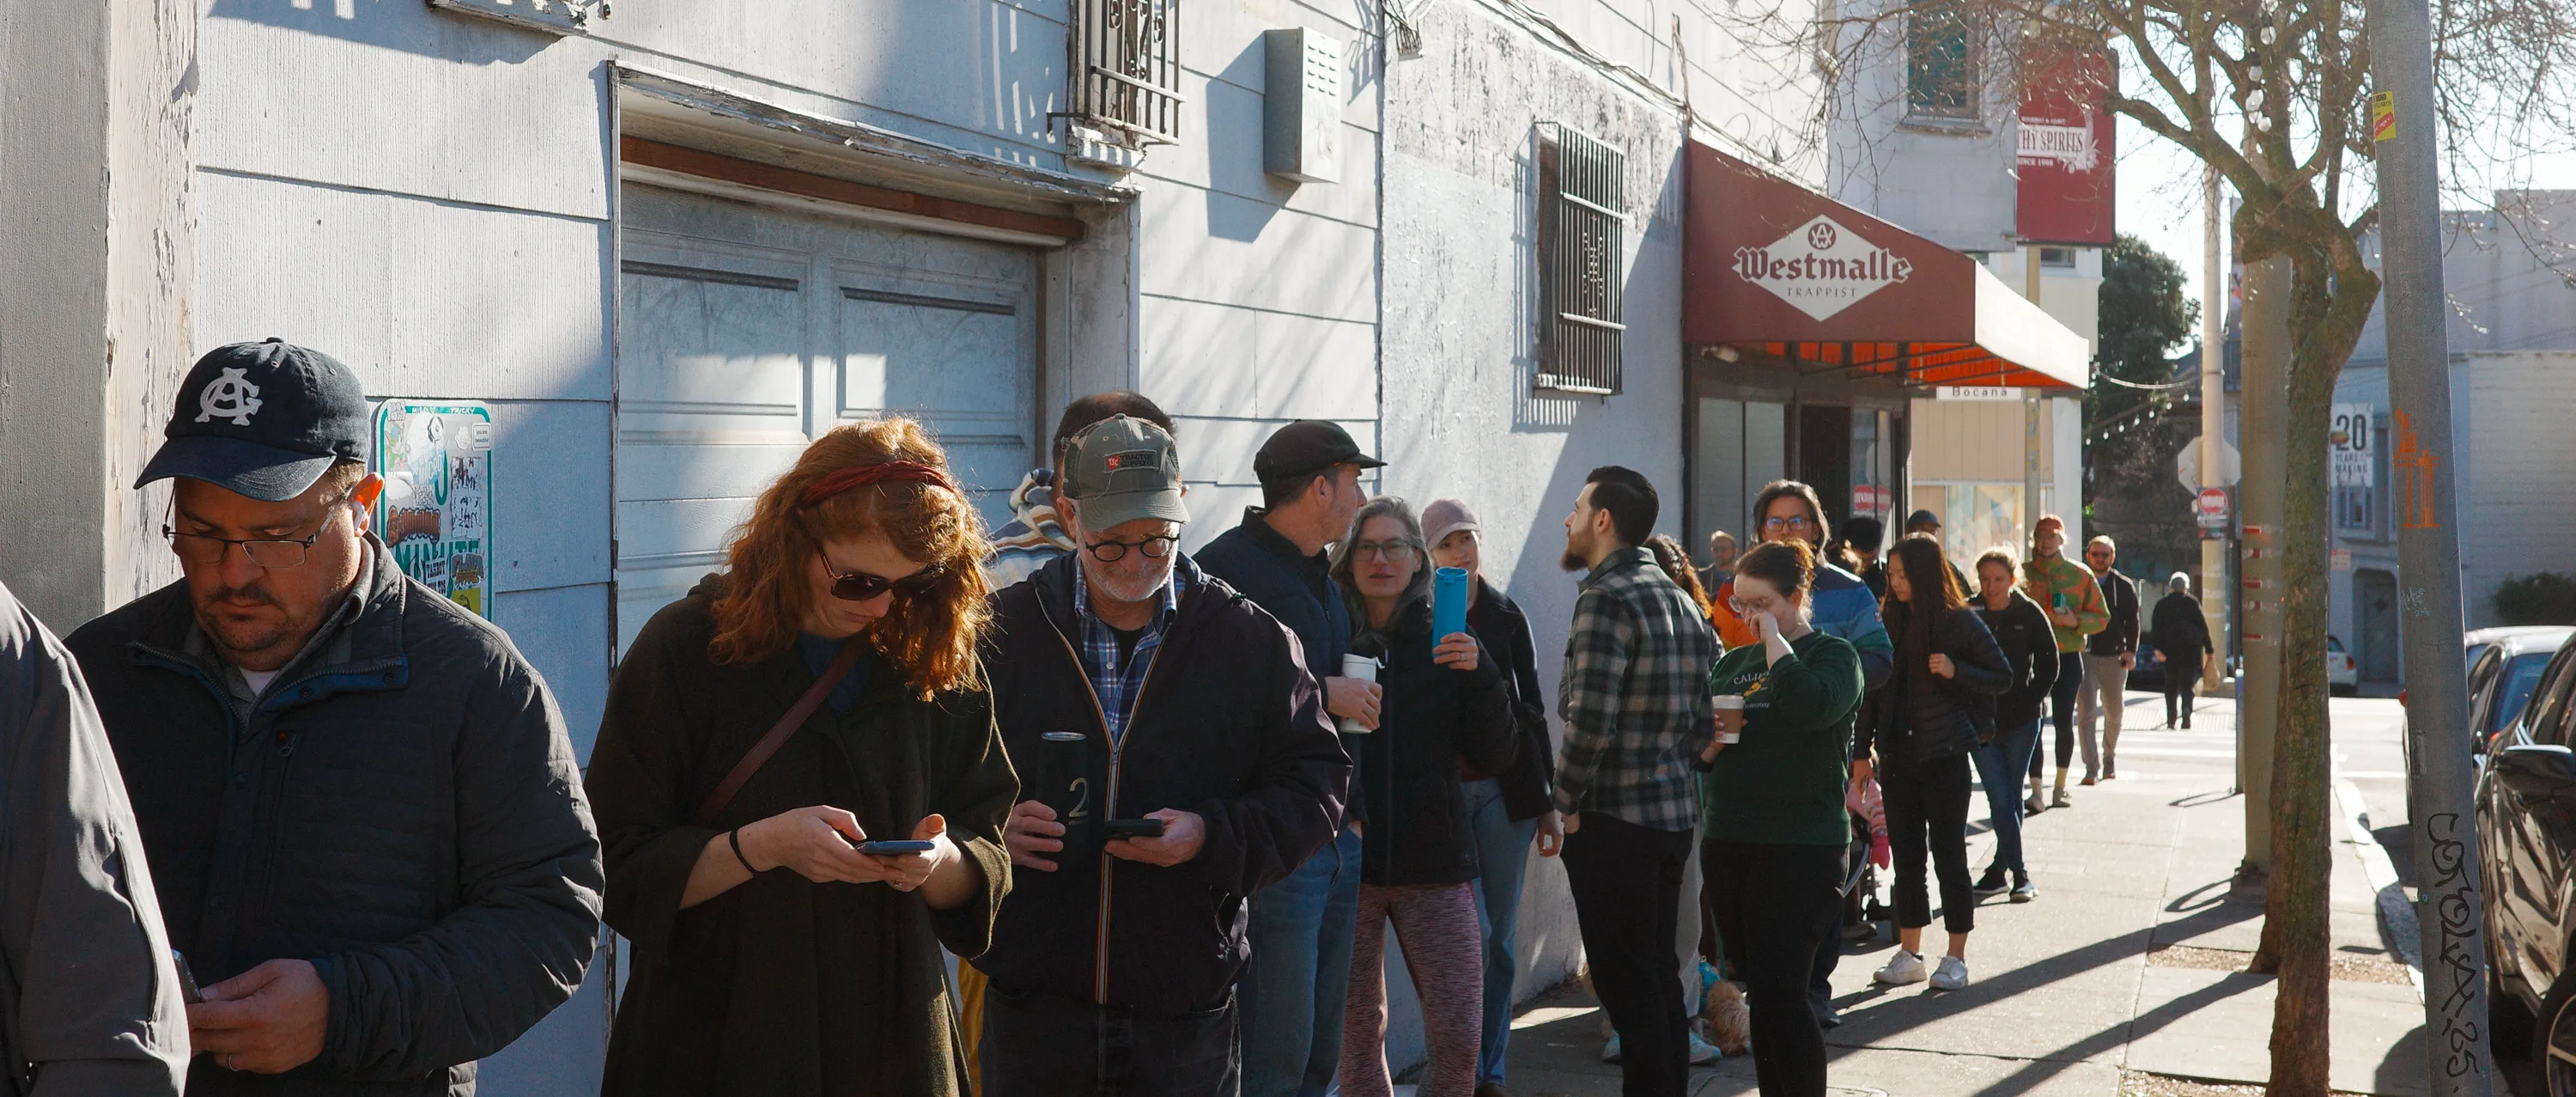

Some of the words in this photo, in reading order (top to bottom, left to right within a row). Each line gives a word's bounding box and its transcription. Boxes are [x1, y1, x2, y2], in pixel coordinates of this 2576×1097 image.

[2040, 130, 2084, 153] SPIRITS
[1734, 249, 1911, 282] Westmalle
[1787, 287, 1856, 297] TRAPPIST
[2336, 414, 2366, 451] 20
